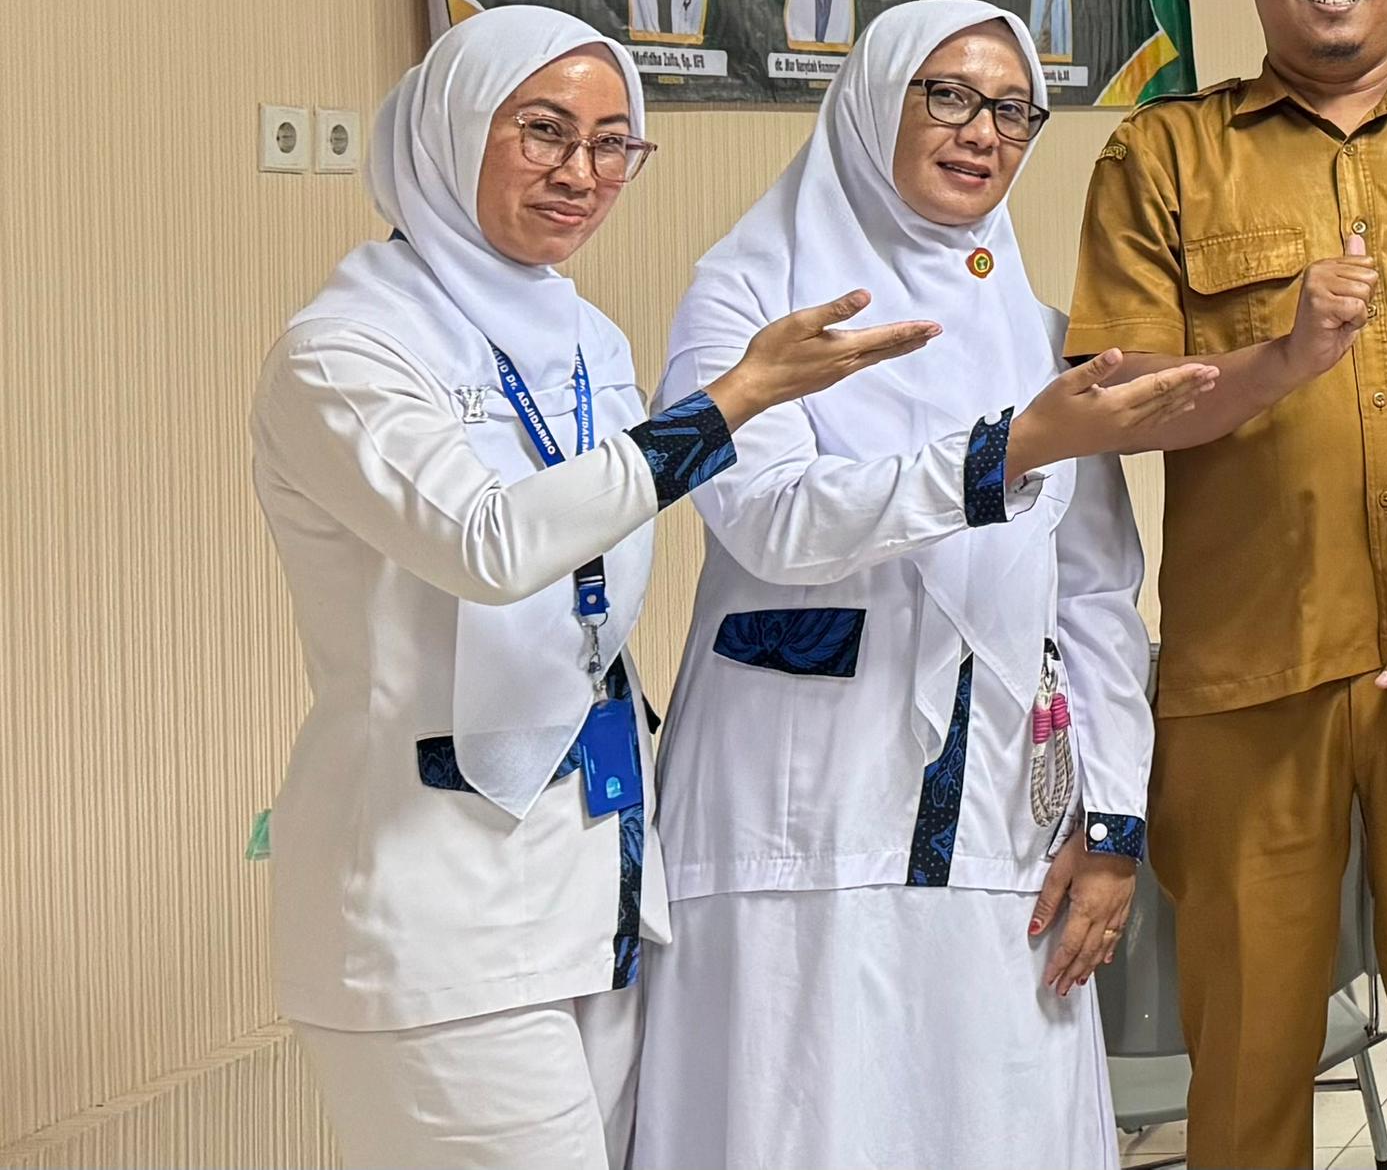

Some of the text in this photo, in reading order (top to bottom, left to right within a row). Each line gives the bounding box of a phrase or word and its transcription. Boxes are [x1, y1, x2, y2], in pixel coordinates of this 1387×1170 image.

[493, 349, 556, 455] SUD Dr. ADJIDARMO
[580, 396, 590, 453] ADJIDARM
